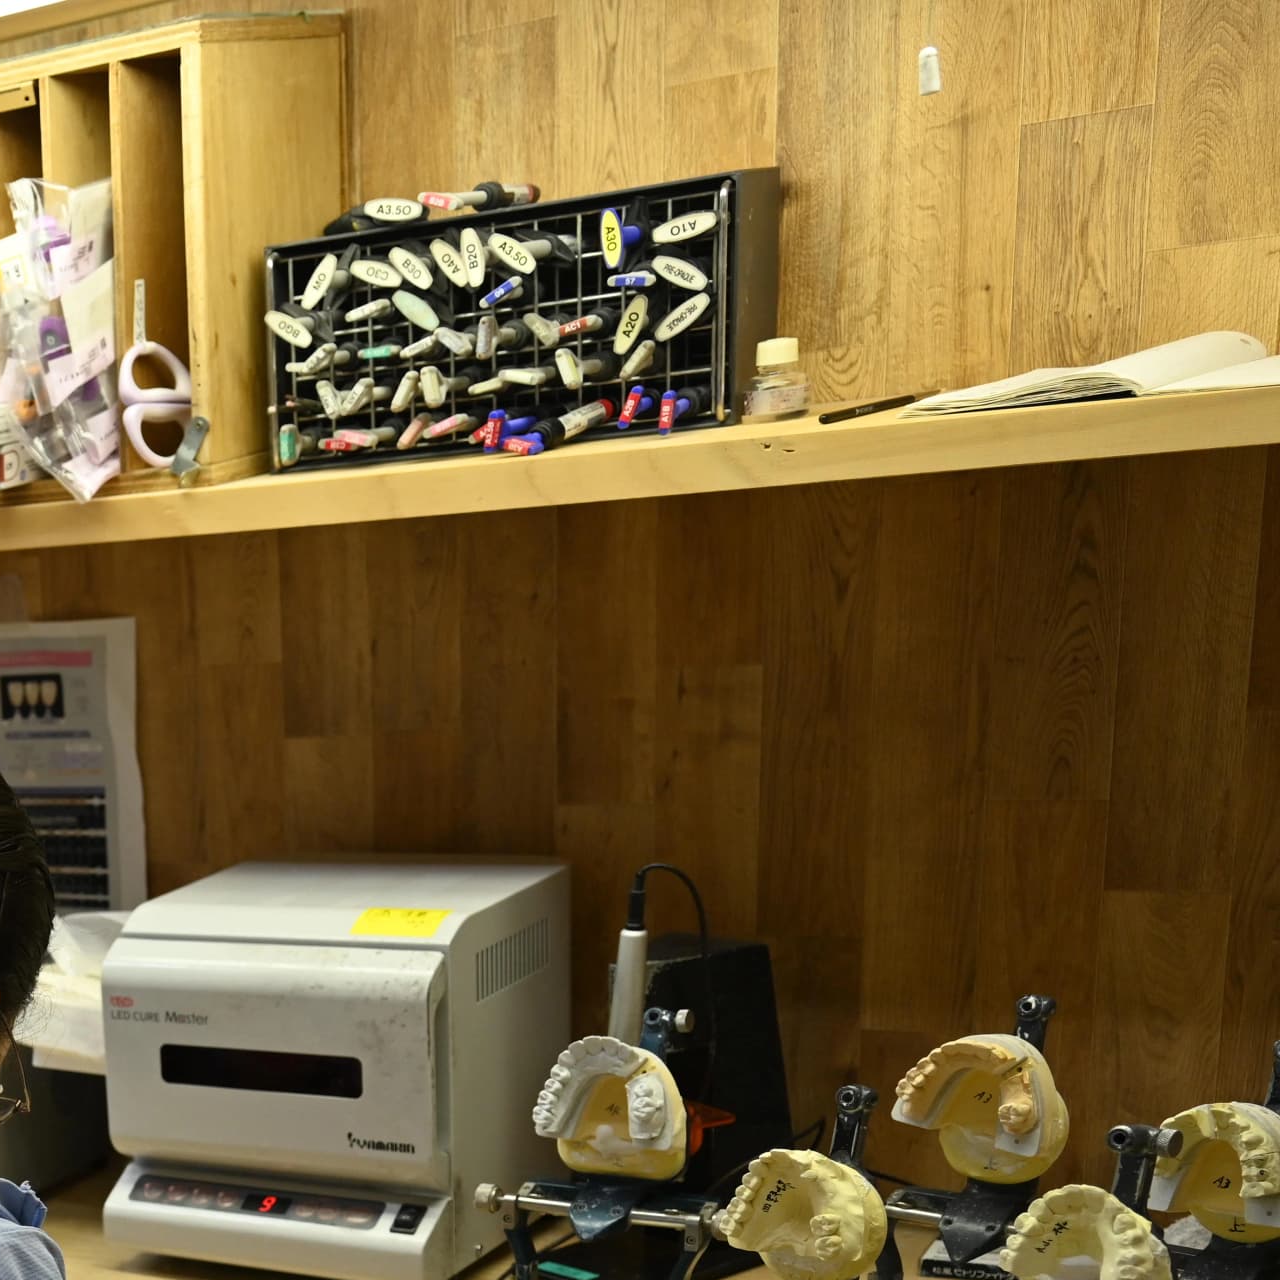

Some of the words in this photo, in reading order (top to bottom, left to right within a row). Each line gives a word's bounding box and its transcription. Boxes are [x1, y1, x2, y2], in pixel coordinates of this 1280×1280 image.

[111, 1009, 130, 1020] LED
[164, 1010, 208, 1025] Master
[258, 1195, 277, 1212] 9
